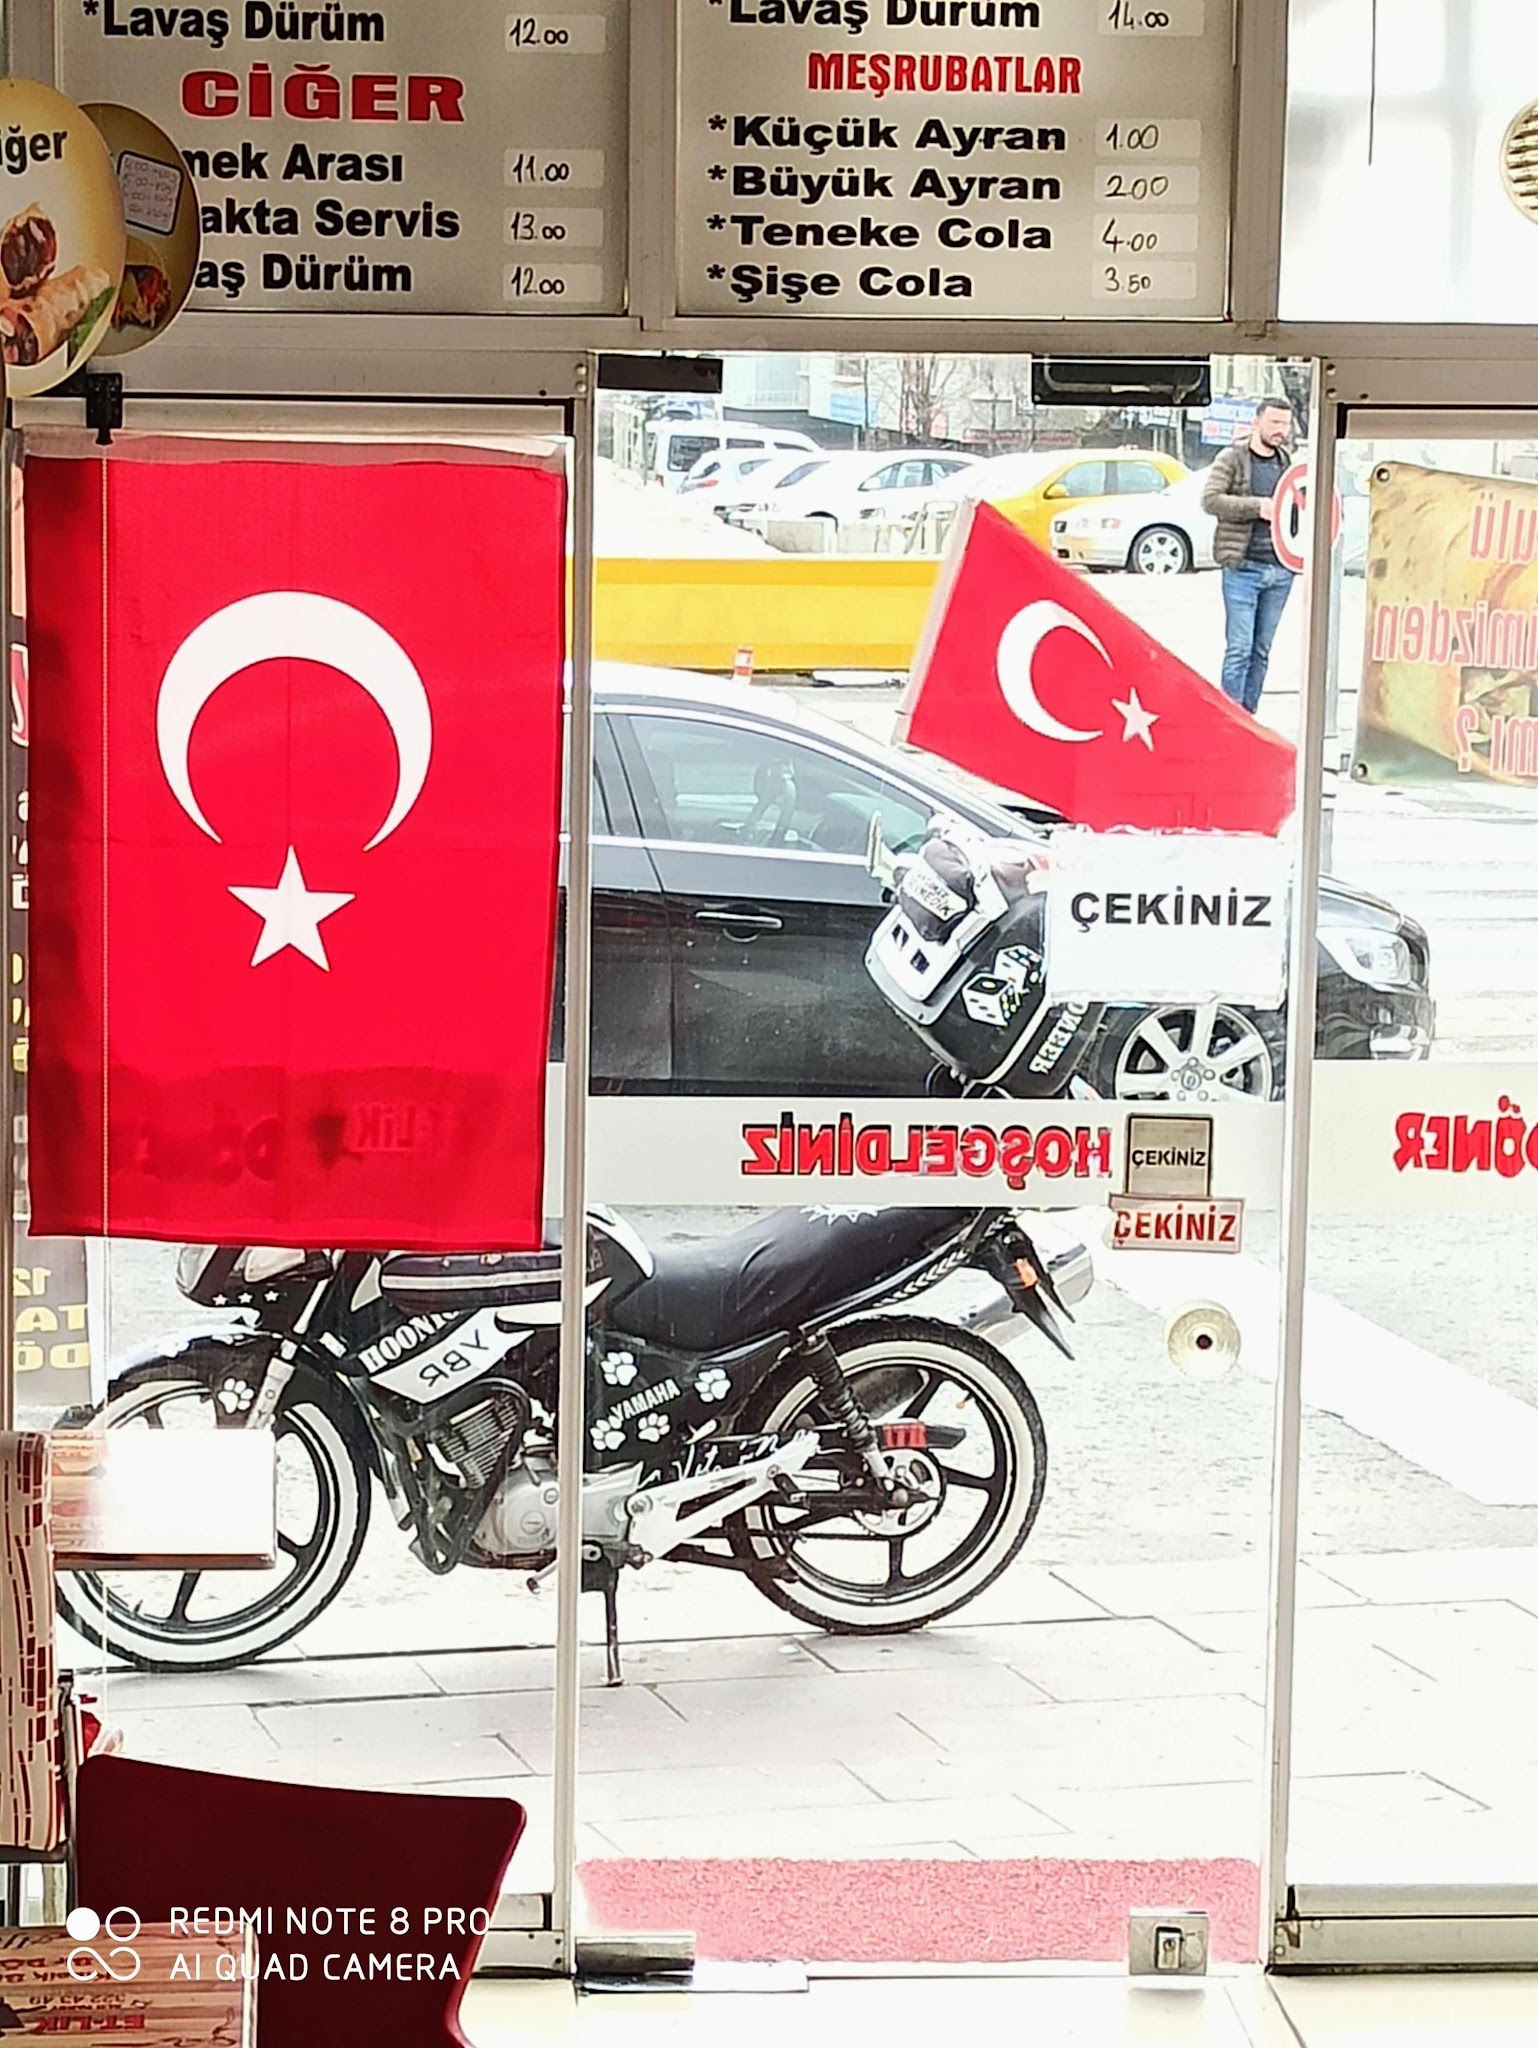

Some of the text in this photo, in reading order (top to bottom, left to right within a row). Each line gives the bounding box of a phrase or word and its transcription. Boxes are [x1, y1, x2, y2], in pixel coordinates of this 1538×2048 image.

[245, 1, 384, 41] Dürüm
[510, 18, 569, 46] 12.00
[1108, 0, 1169, 29] 14.00
[182, 62, 466, 122] CİĞER
[808, 52, 1081, 97] MEŞRUBATLAR
[915, 119, 1066, 157] Ayran
[1106, 123, 1159, 150] 1.00
[283, 143, 403, 182] Arası
[513, 153, 570, 183] 11.00
[910, 169, 1060, 206] Ayran
[315, 198, 460, 238] Servis
[511, 212, 566, 240] 13.00
[938, 218, 1051, 249] Cola
[1102, 218, 1157, 252] 4.00
[263, 253, 411, 291] Dürüm
[511, 266, 565, 296] 12.00
[860, 266, 972, 297] Cola
[1105, 267, 1150, 293] 3.50
[1071, 885, 1272, 933] ÇEKİNİZ
[1132, 1147, 1207, 1169] ÇEKİNİZ
[1114, 1204, 1236, 1246] ÇEKİNİZ
[610, 1378, 681, 1420] YAMAHA
